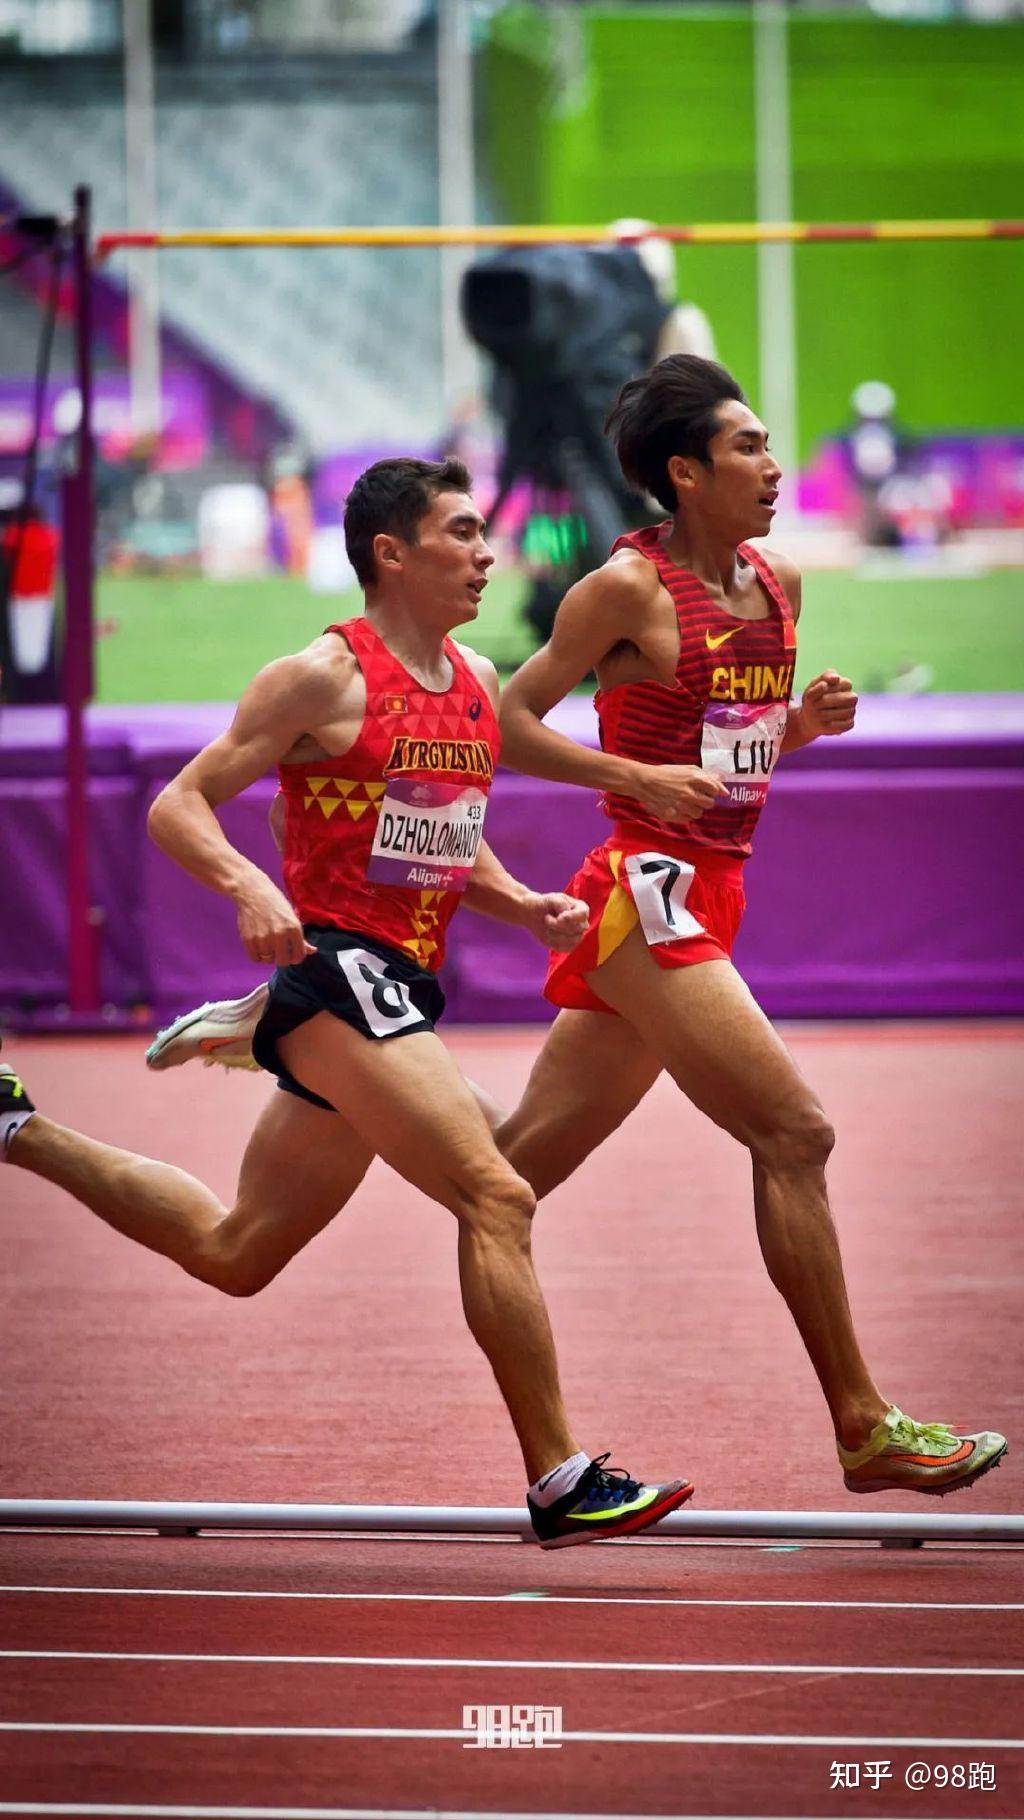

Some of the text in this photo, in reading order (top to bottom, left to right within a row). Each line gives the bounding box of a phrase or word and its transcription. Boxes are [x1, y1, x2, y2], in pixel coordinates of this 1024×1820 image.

[733, 740, 774, 774] LIU
[731, 786, 761, 803] Alipay
[467, 806, 481, 819] 433
[407, 868, 442, 886] Alipay
[640, 860, 680, 925] 7
